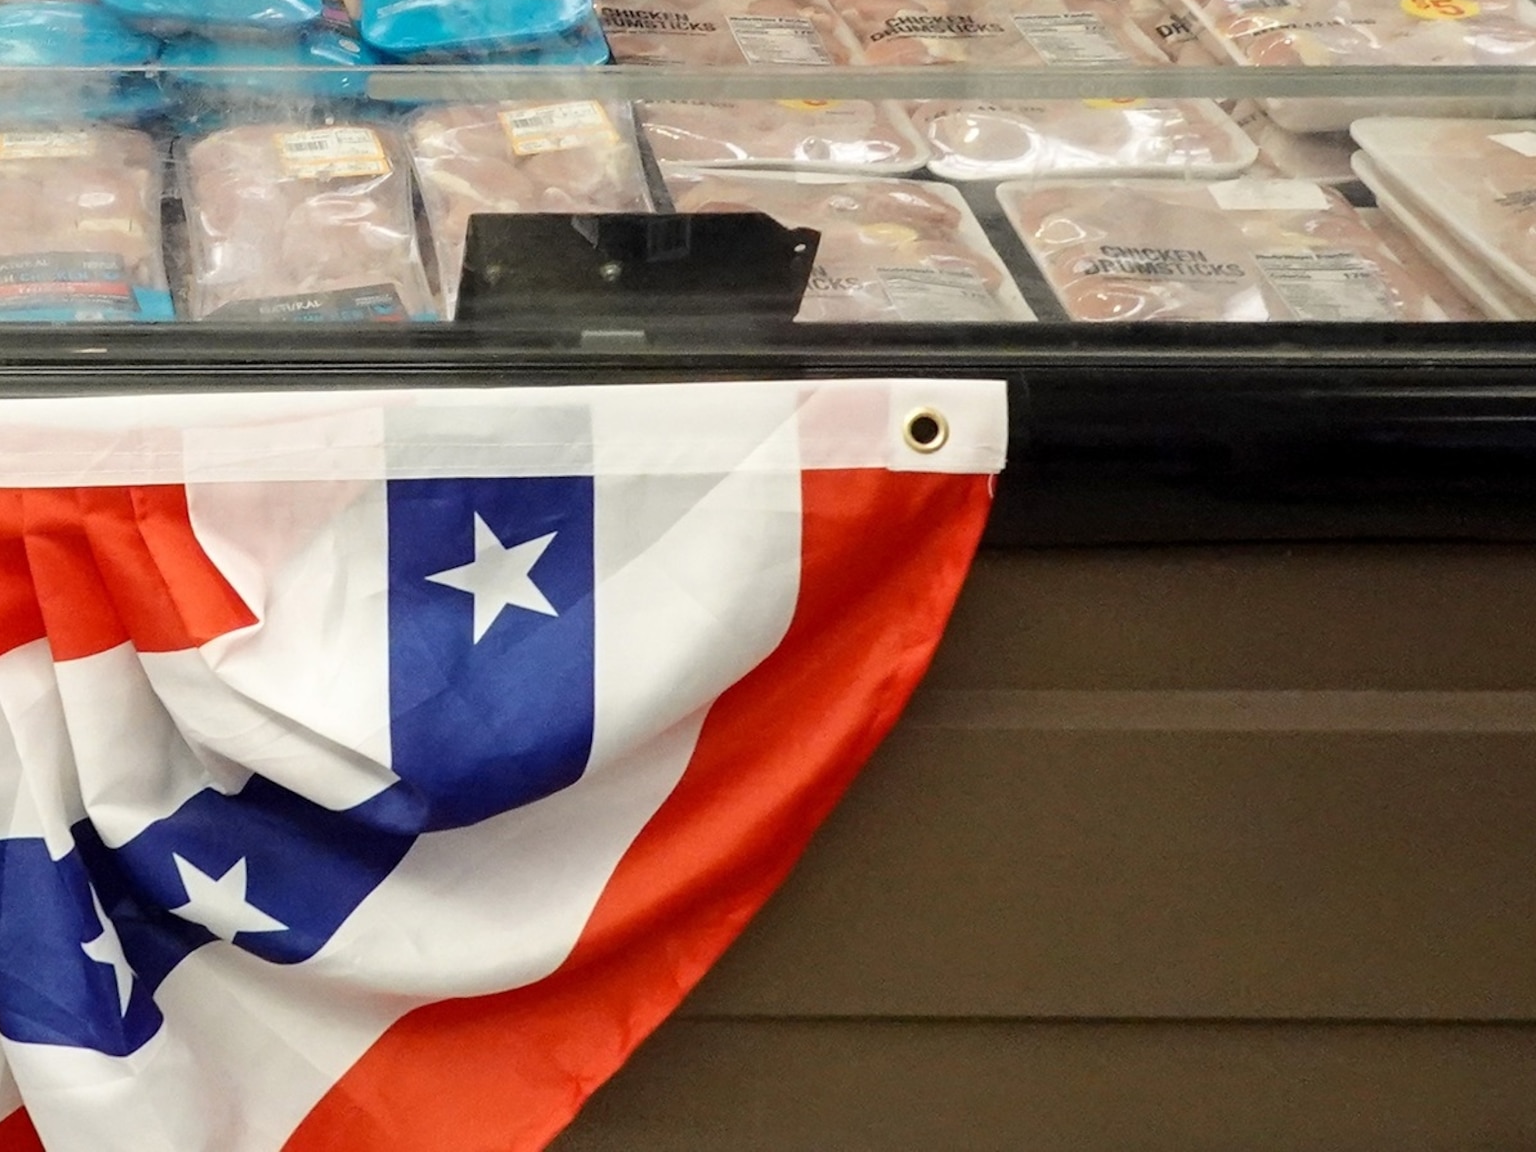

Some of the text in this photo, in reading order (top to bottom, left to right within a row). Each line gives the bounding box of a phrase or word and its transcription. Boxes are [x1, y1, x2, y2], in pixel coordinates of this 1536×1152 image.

[601, 7, 691, 22] CHICKEN
[884, 15, 975, 27] CHICKEN
[602, 19, 717, 33] UMSTICKS
[869, 22, 1005, 43] DRUMSTICKS
[1099, 245, 1208, 262] CHICKEN
[1083, 260, 1246, 278] DRUMSTICKS
